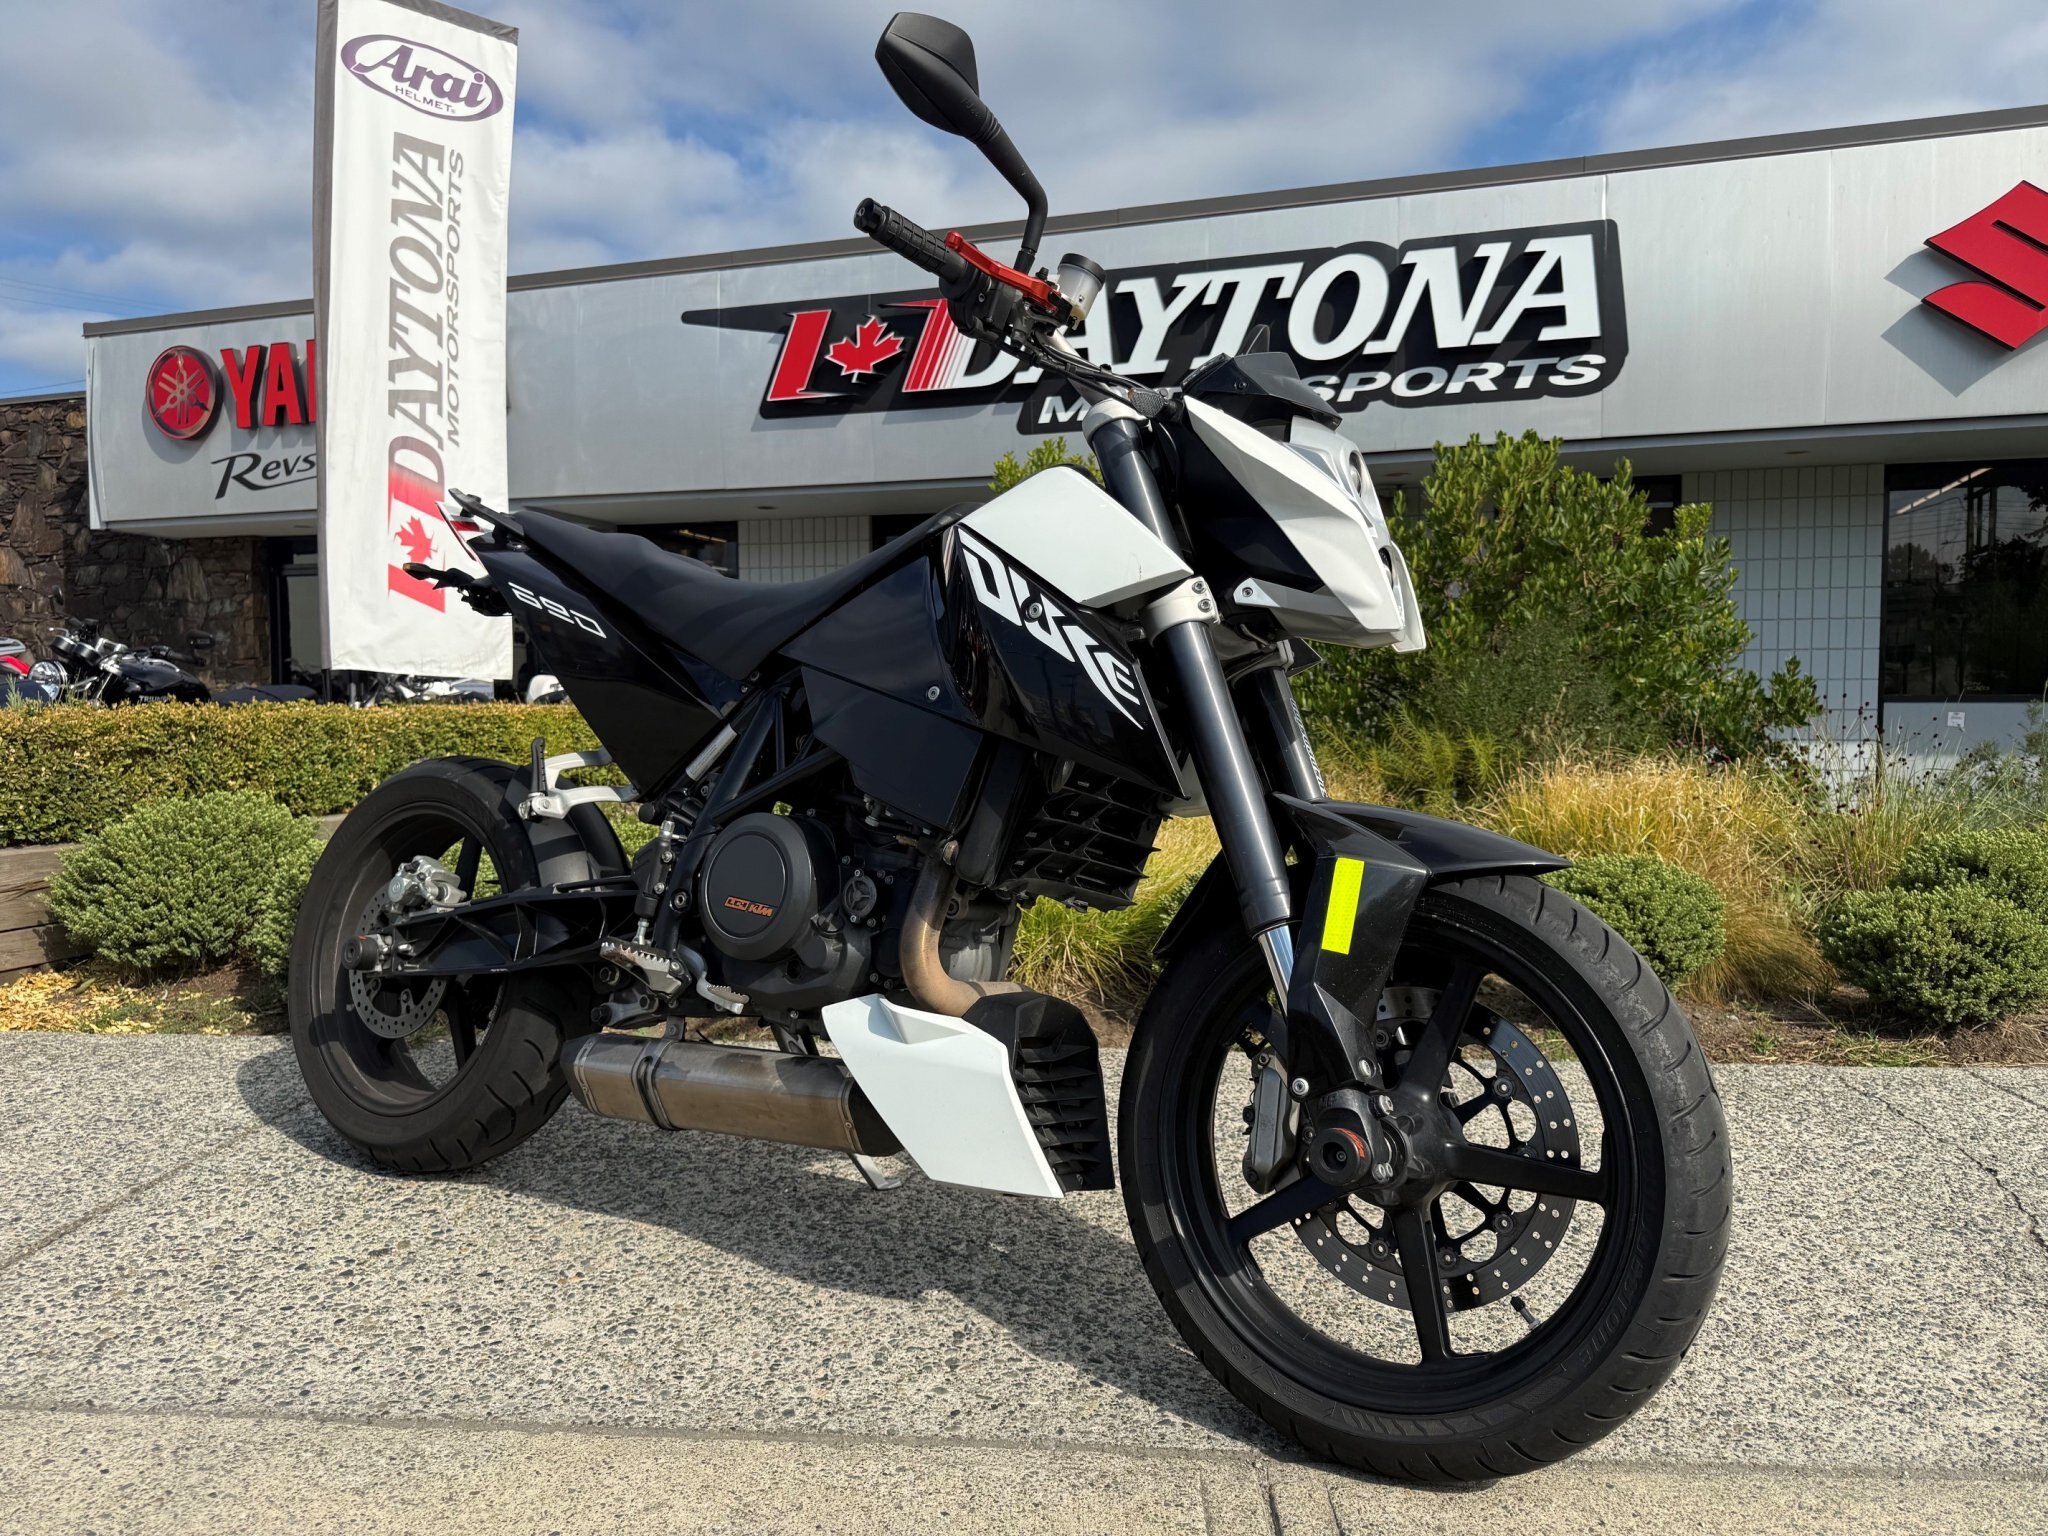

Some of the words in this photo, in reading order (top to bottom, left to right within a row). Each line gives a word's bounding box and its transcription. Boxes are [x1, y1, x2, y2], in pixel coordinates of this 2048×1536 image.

[351, 44, 487, 108] Arai
[394, 84, 453, 114] HELMET
[387, 131, 446, 523] DAYTONA
[446, 148, 464, 448] MOTORSPORTS
[1038, 353, 1607, 424] MSPORTS
[508, 581, 607, 639] 690
[957, 527, 1145, 731] DUKE
